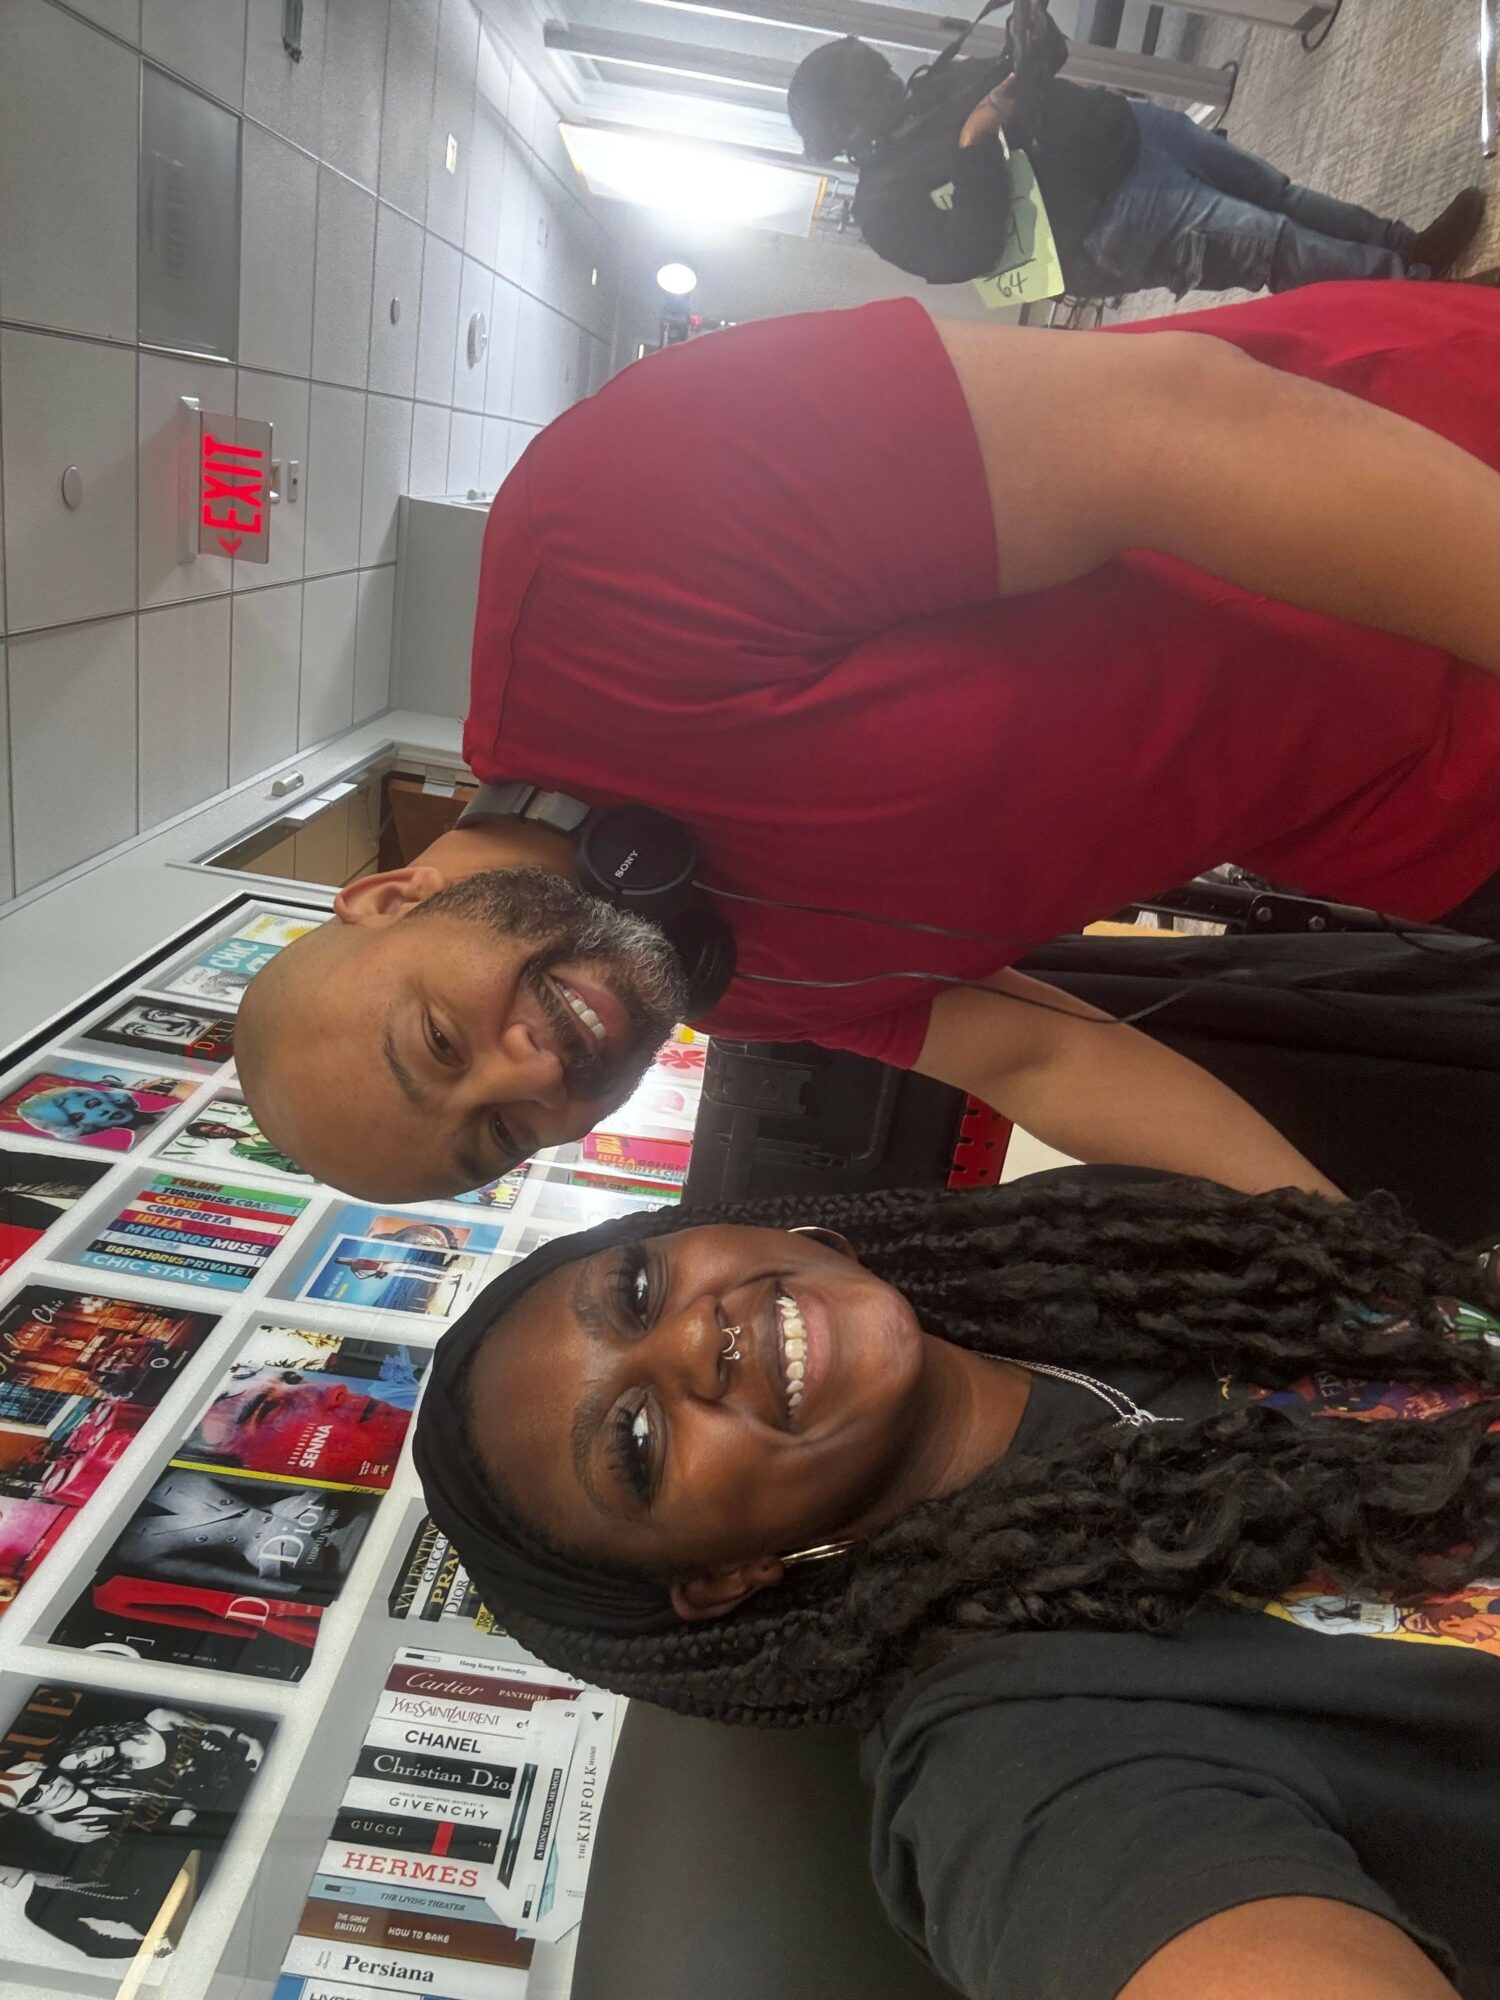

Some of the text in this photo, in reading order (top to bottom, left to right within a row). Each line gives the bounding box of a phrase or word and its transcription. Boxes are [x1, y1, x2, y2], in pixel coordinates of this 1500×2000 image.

[998, 272, 1028, 298] 64
[203, 434, 264, 534] EXIT
[614, 849, 639, 878] SONY
[162, 1187, 233, 1205] TURQUOISE
[170, 1176, 224, 1193] TULUM
[146, 1204, 232, 1226] COMPORTA
[155, 1195, 201, 1210] CAPRI
[134, 1213, 182, 1230] IBIZA
[125, 1223, 213, 1246] MYKONOS
[212, 1238, 263, 1255] MUSE
[92, 1255, 210, 1283] CHIC STAYS
[105, 1245, 245, 1276] BOSPHORUS PRIVATE
[299, 1425, 334, 1469] SENNA
[258, 1500, 325, 1569] Dior
[423, 1536, 448, 1583] GUCCI
[430, 1546, 459, 1605] PRA
[443, 1579, 469, 1615] DIOR
[405, 1672, 485, 1697] Cartier
[405, 1730, 482, 1754] CHANEL
[373, 1754, 513, 1791] Christian Dio
[388, 1797, 489, 1820] GIVENCHY
[542, 1803, 554, 1826] KONG
[577, 1765, 598, 1844] KINFOLK
[351, 1819, 403, 1837] GUCCI
[538, 1826, 550, 1851] HONG
[578, 1845, 586, 1860] THE
[380, 1892, 466, 1913] THE LIVING THEATER
[388, 1926, 450, 1944] HOW TO BAKE
[342, 1954, 434, 1983] Persiana
